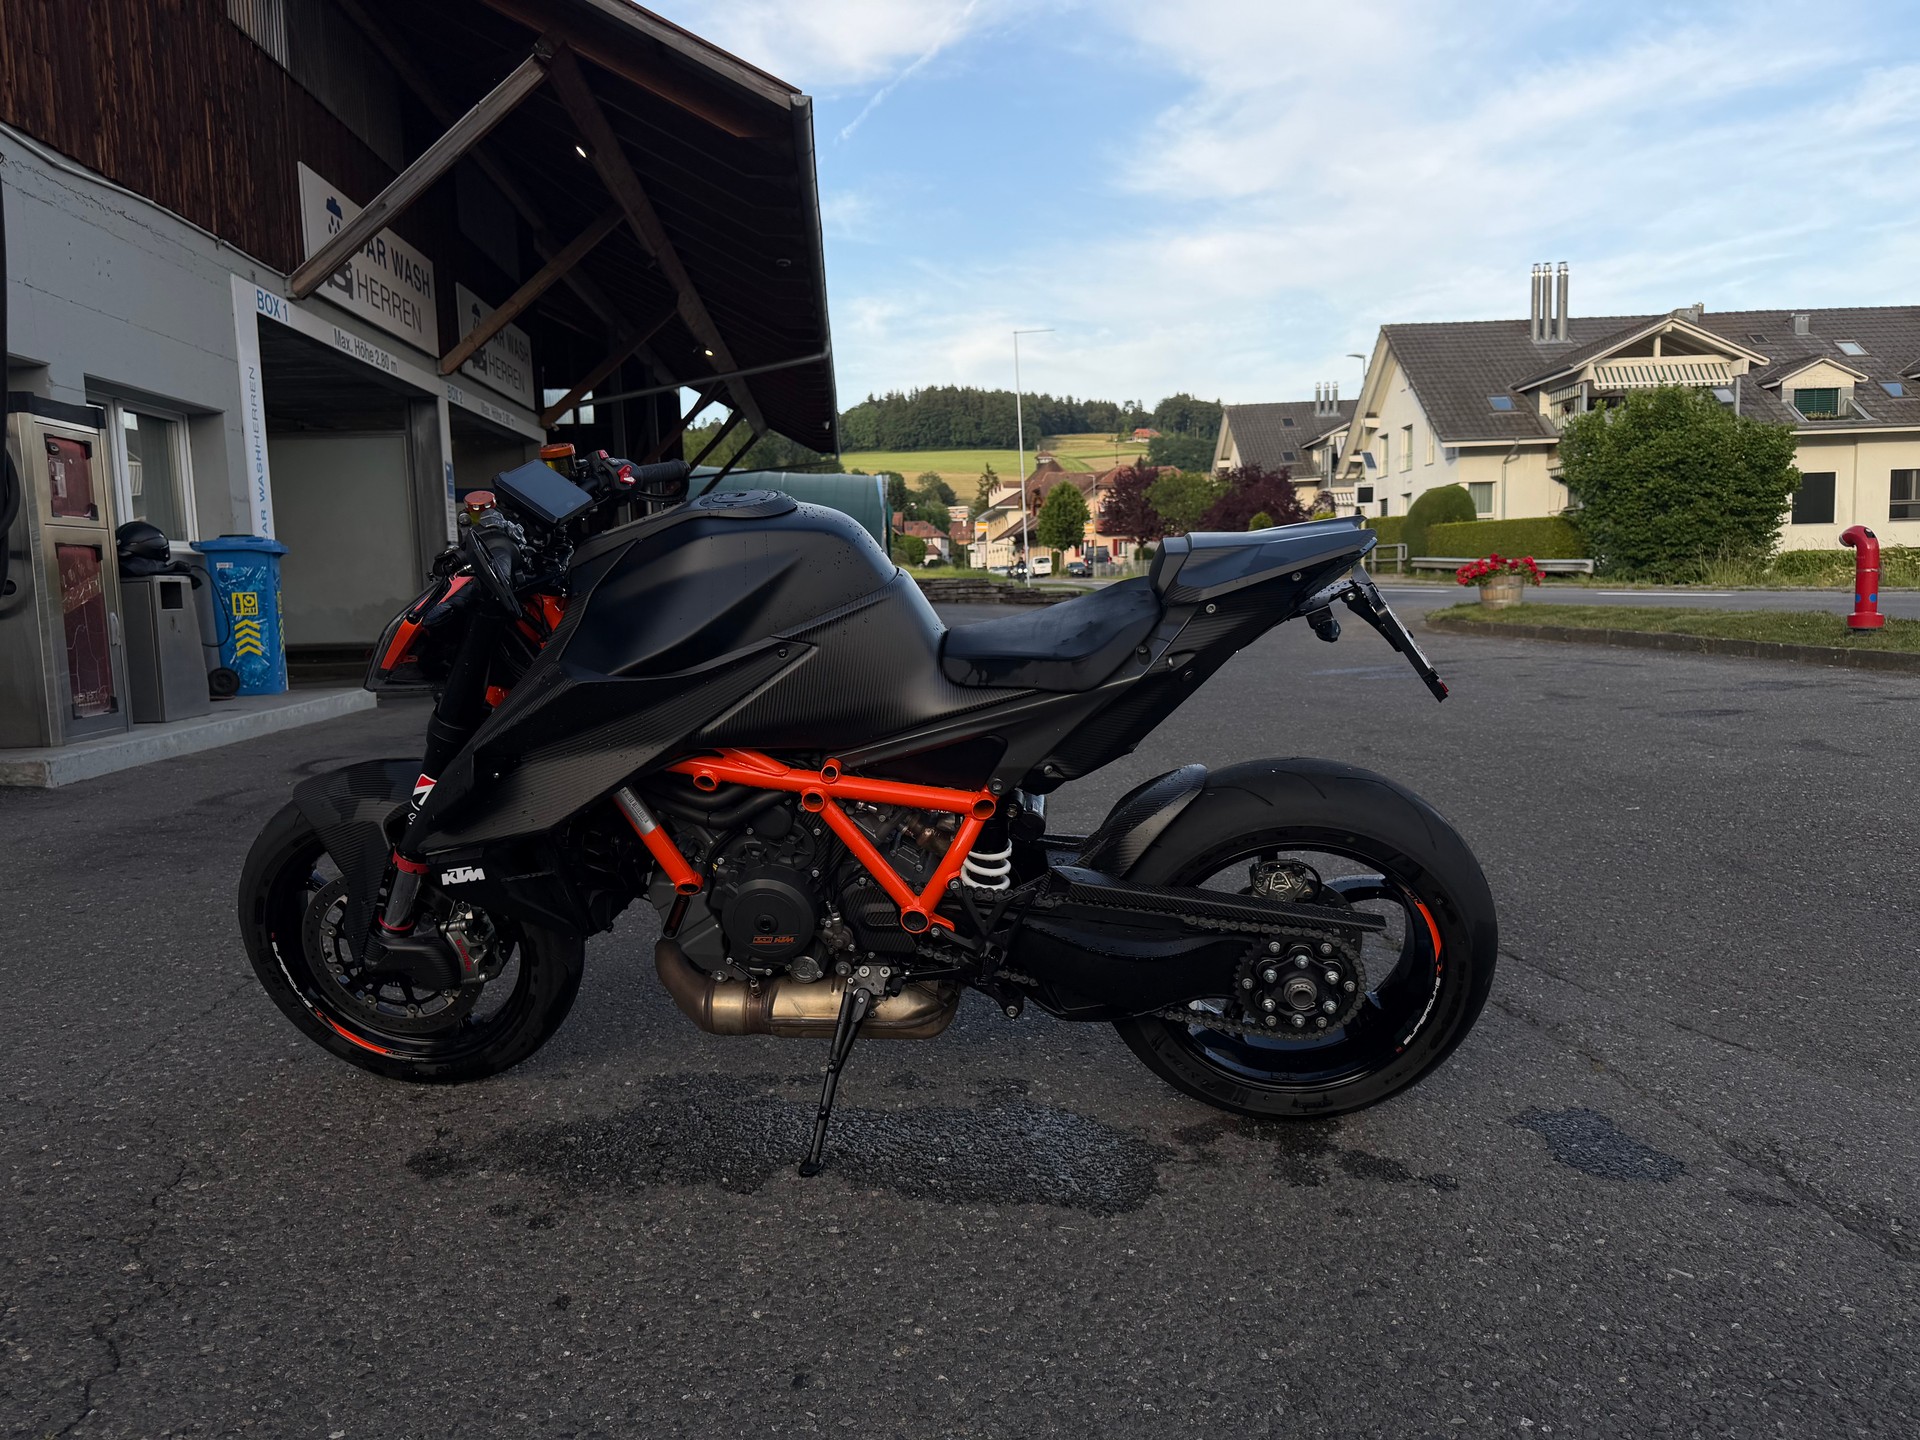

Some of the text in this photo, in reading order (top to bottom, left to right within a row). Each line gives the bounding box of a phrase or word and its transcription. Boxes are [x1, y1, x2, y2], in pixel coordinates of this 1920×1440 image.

[359, 236, 431, 299] AR WASH
[256, 289, 288, 322] BOX 1
[356, 268, 422, 334] HERREN
[333, 327, 398, 375] Max. Höhe 2.80 m
[487, 352, 526, 393] HERREN
[505, 330, 530, 367] WASH
[248, 366, 261, 448] HERREN
[254, 449, 266, 503] WASH
[441, 866, 486, 886] KTM
